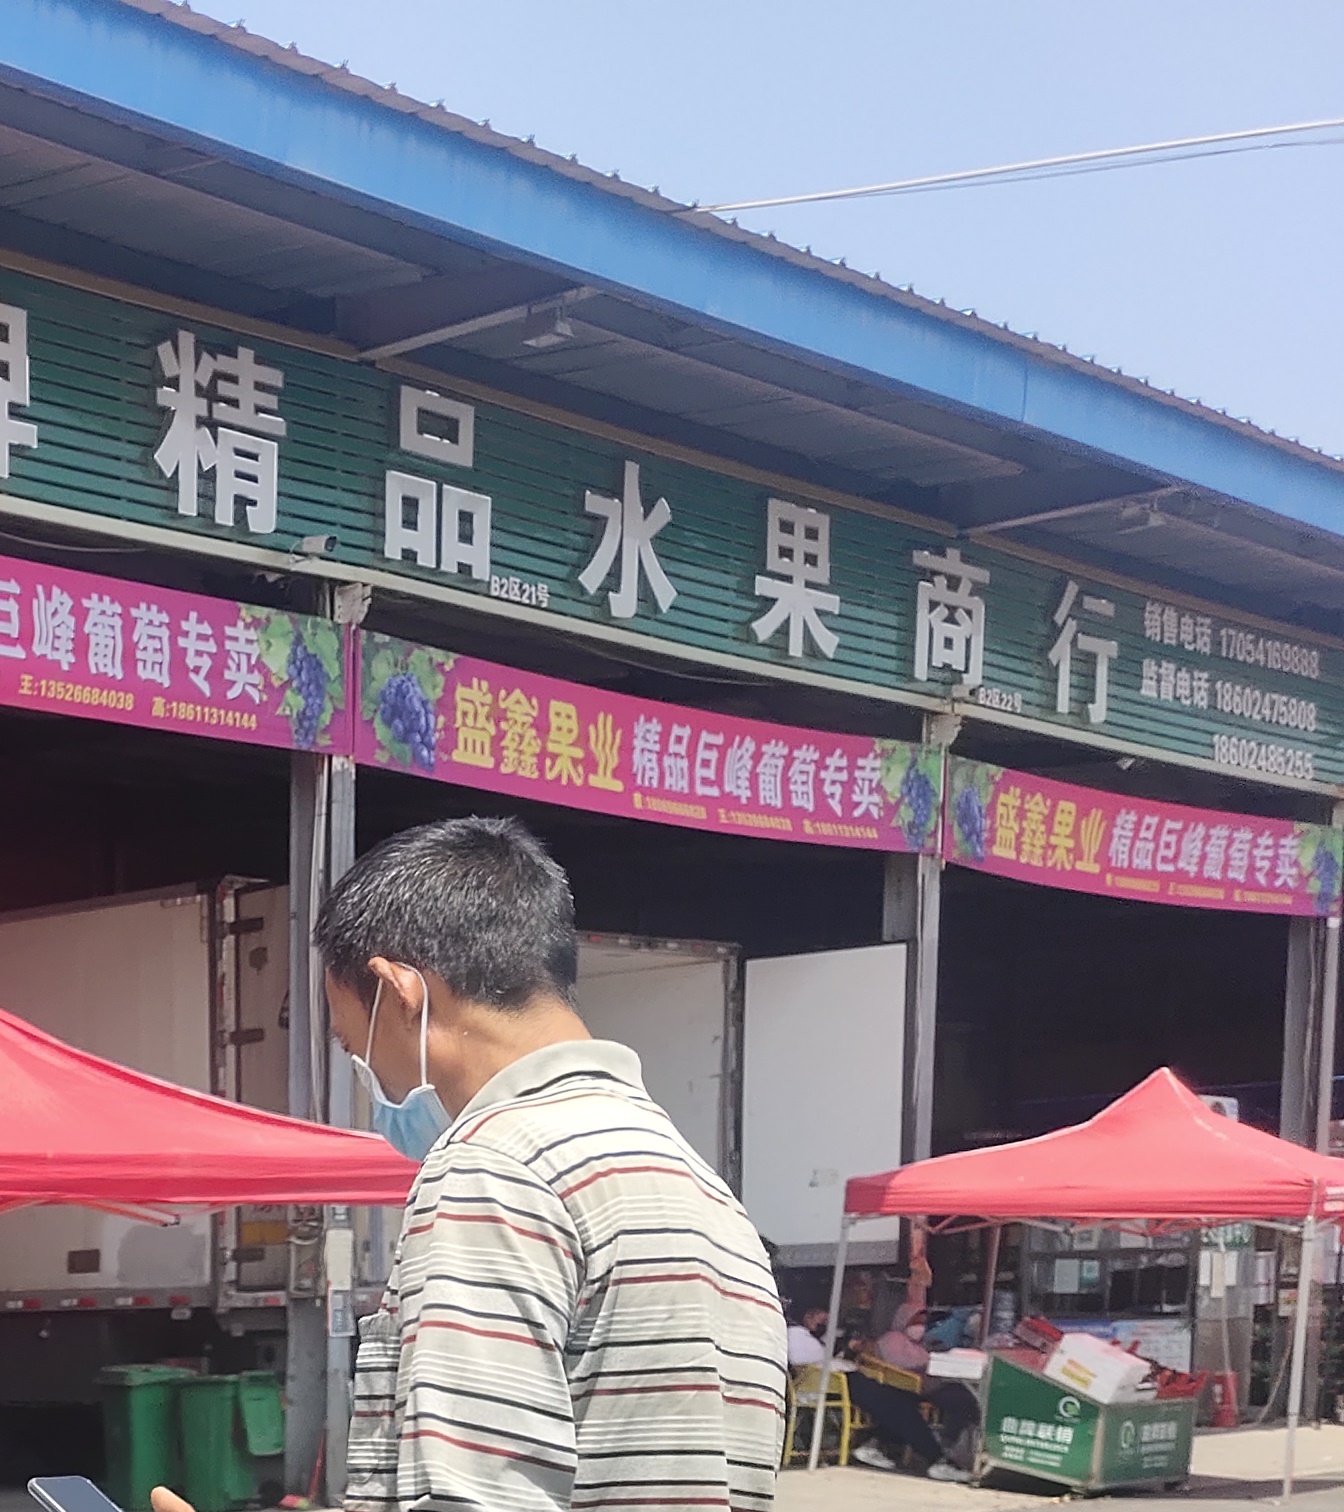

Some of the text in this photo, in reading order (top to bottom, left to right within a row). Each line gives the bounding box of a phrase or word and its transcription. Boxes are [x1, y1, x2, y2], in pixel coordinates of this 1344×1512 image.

[491, 575, 551, 608] B2区21号
[1144, 601, 1212, 655] 销售电话
[1140, 659, 1210, 710] 监督电话
[451, 678, 882, 819] 盛鑫果业 精品巨峰葡萄专卖
[992, 785, 1302, 890] 盛鑫果业 精品巨峰葡萄专卖
